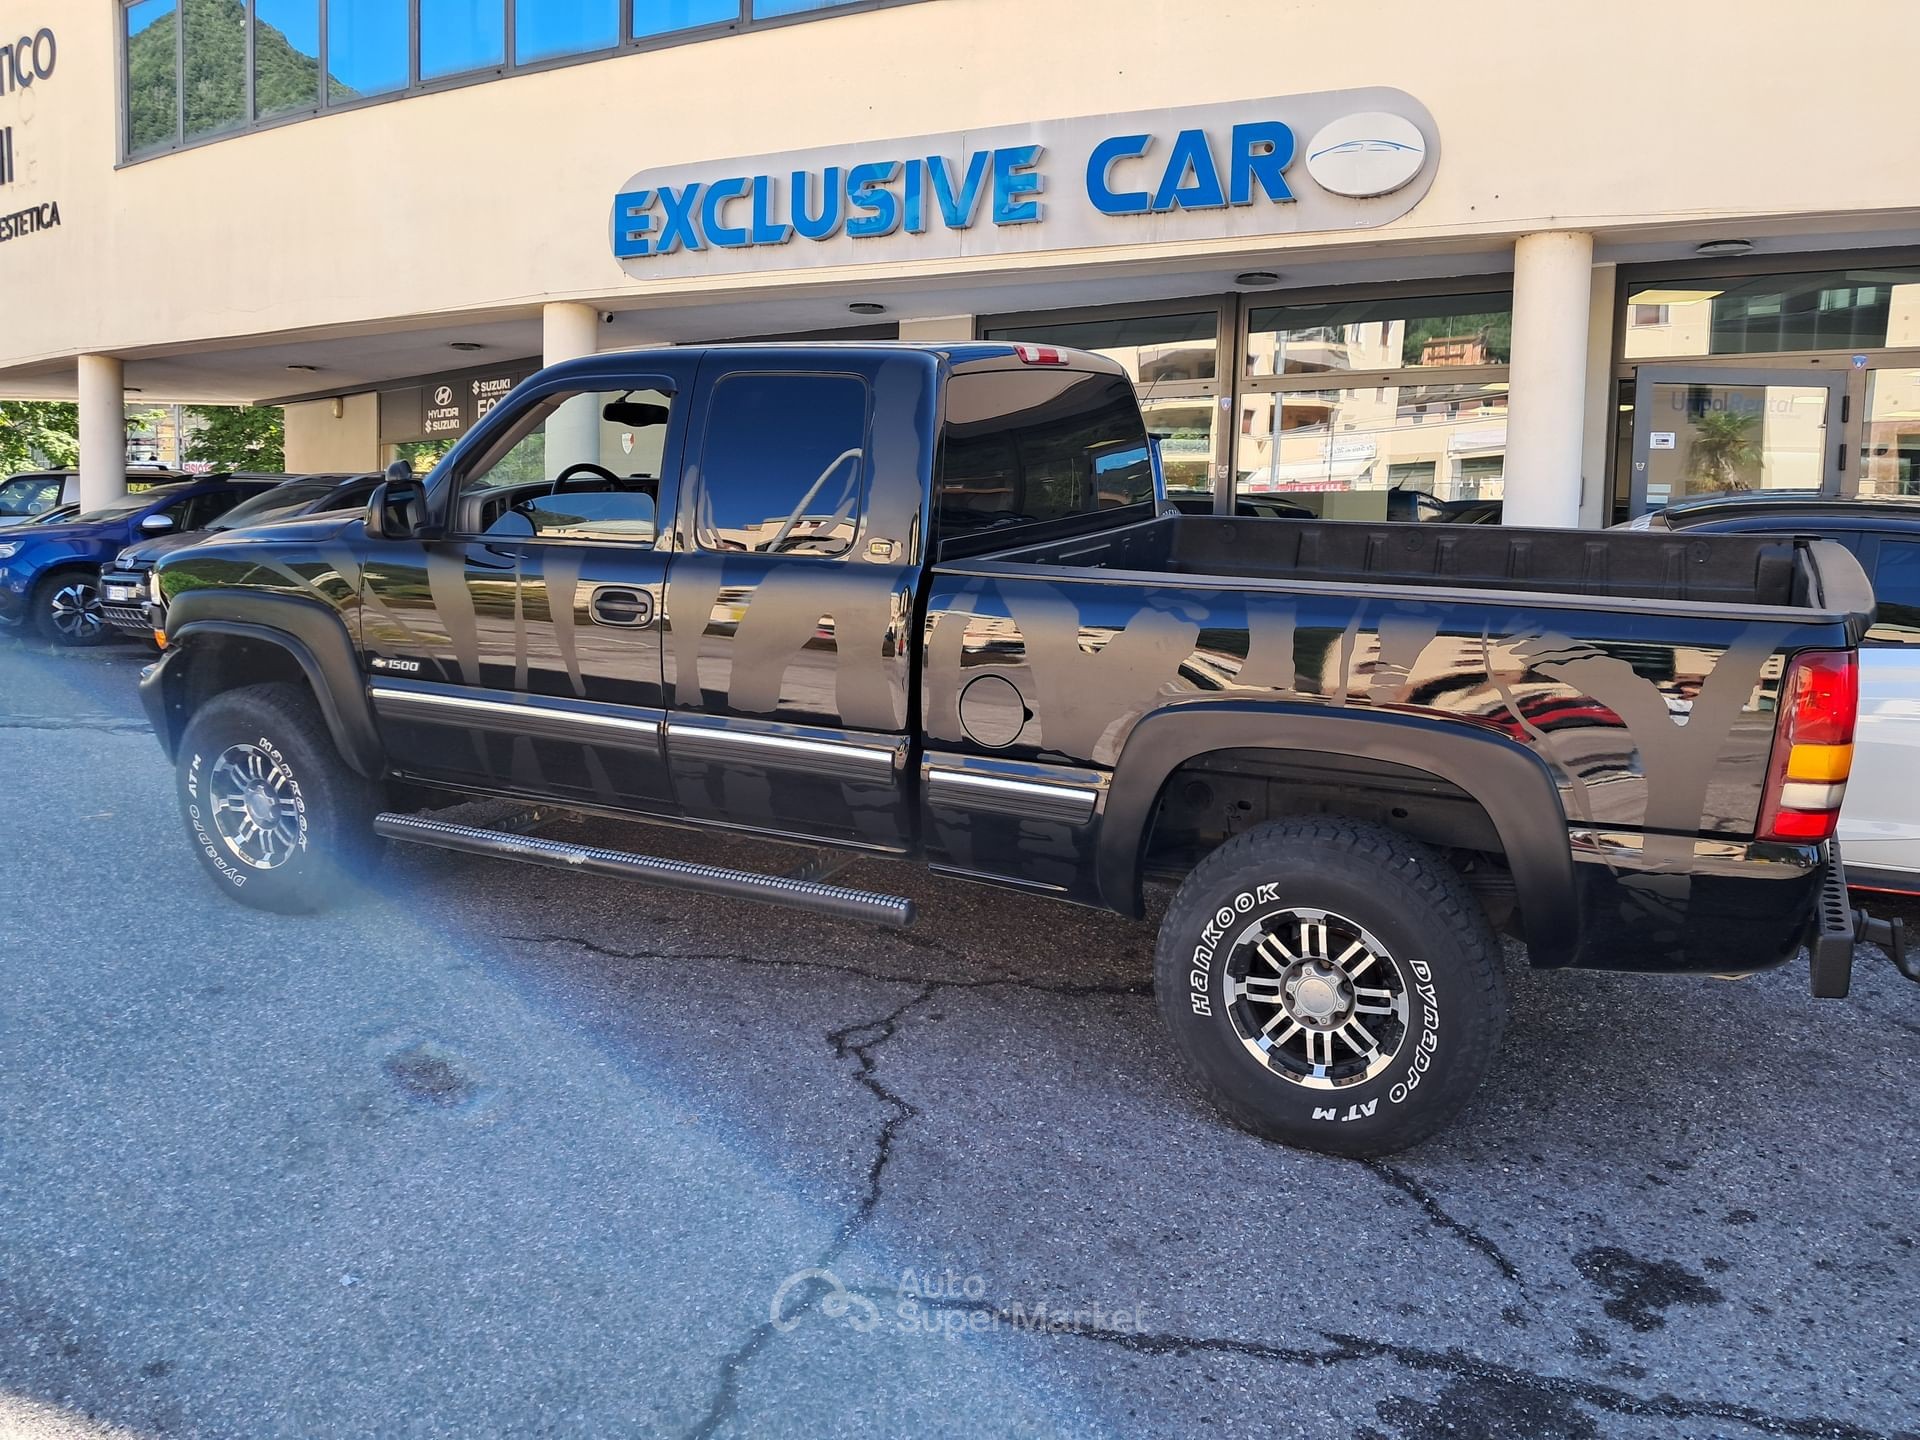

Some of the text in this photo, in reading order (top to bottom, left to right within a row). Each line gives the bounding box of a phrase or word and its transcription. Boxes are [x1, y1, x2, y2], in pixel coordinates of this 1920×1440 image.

[614, 120, 1297, 259] EXCLUSIVE CAR
[480, 378, 511, 392] SUZUKI
[427, 407, 459, 419] HYUNDAI
[432, 419, 460, 431] SUZUKI
[388, 659, 420, 672] 1500
